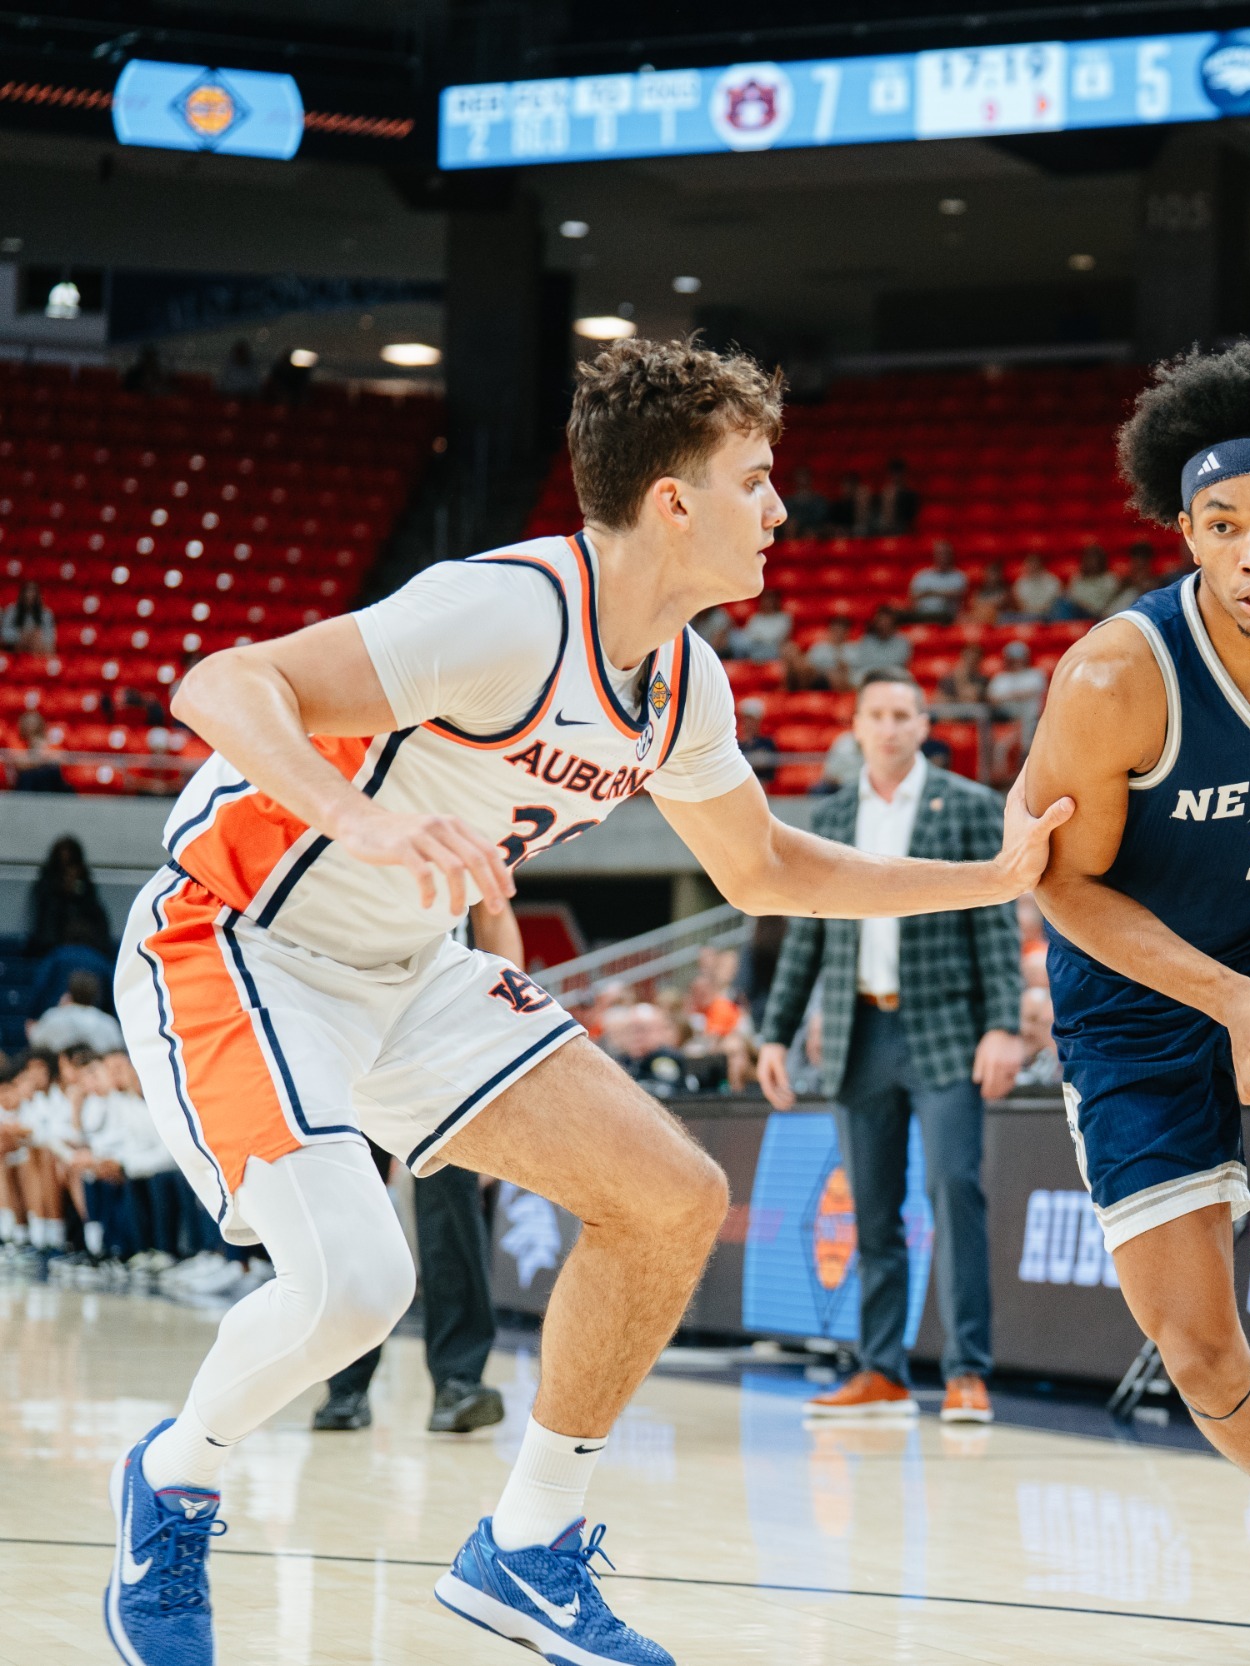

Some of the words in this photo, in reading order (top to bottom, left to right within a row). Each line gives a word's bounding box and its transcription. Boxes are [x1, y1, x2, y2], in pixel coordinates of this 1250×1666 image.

[810, 64, 843, 145] 7
[1137, 42, 1171, 122] 5
[503, 739, 655, 802] AUBURN
